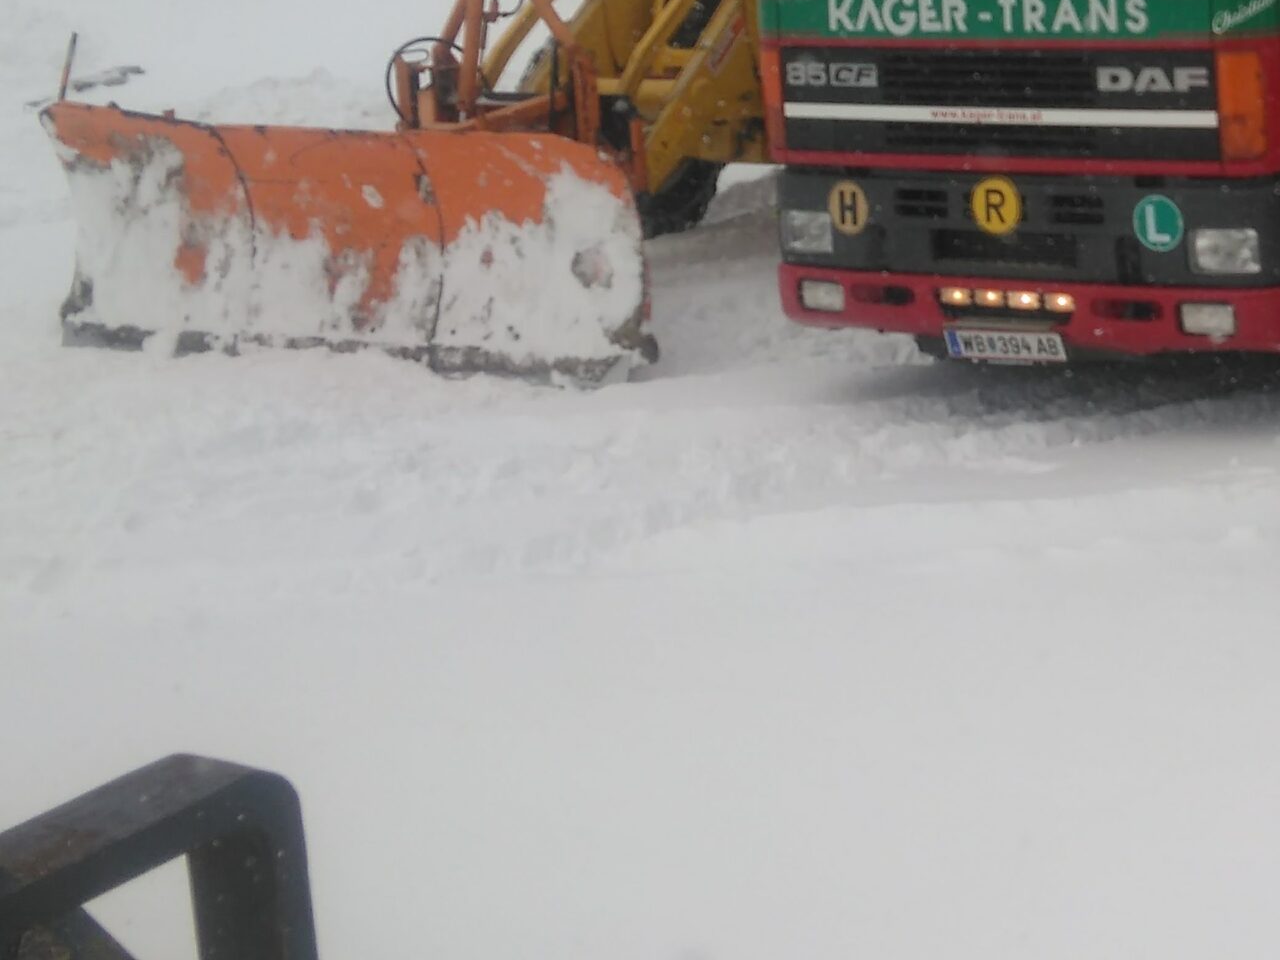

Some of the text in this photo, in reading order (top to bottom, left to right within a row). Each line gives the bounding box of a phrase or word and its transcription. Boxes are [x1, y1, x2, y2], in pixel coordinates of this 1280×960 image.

[1096, 66, 1209, 93] DAF
[838, 191, 858, 226] H
[984, 189, 1006, 224] R
[1145, 204, 1171, 243] L
